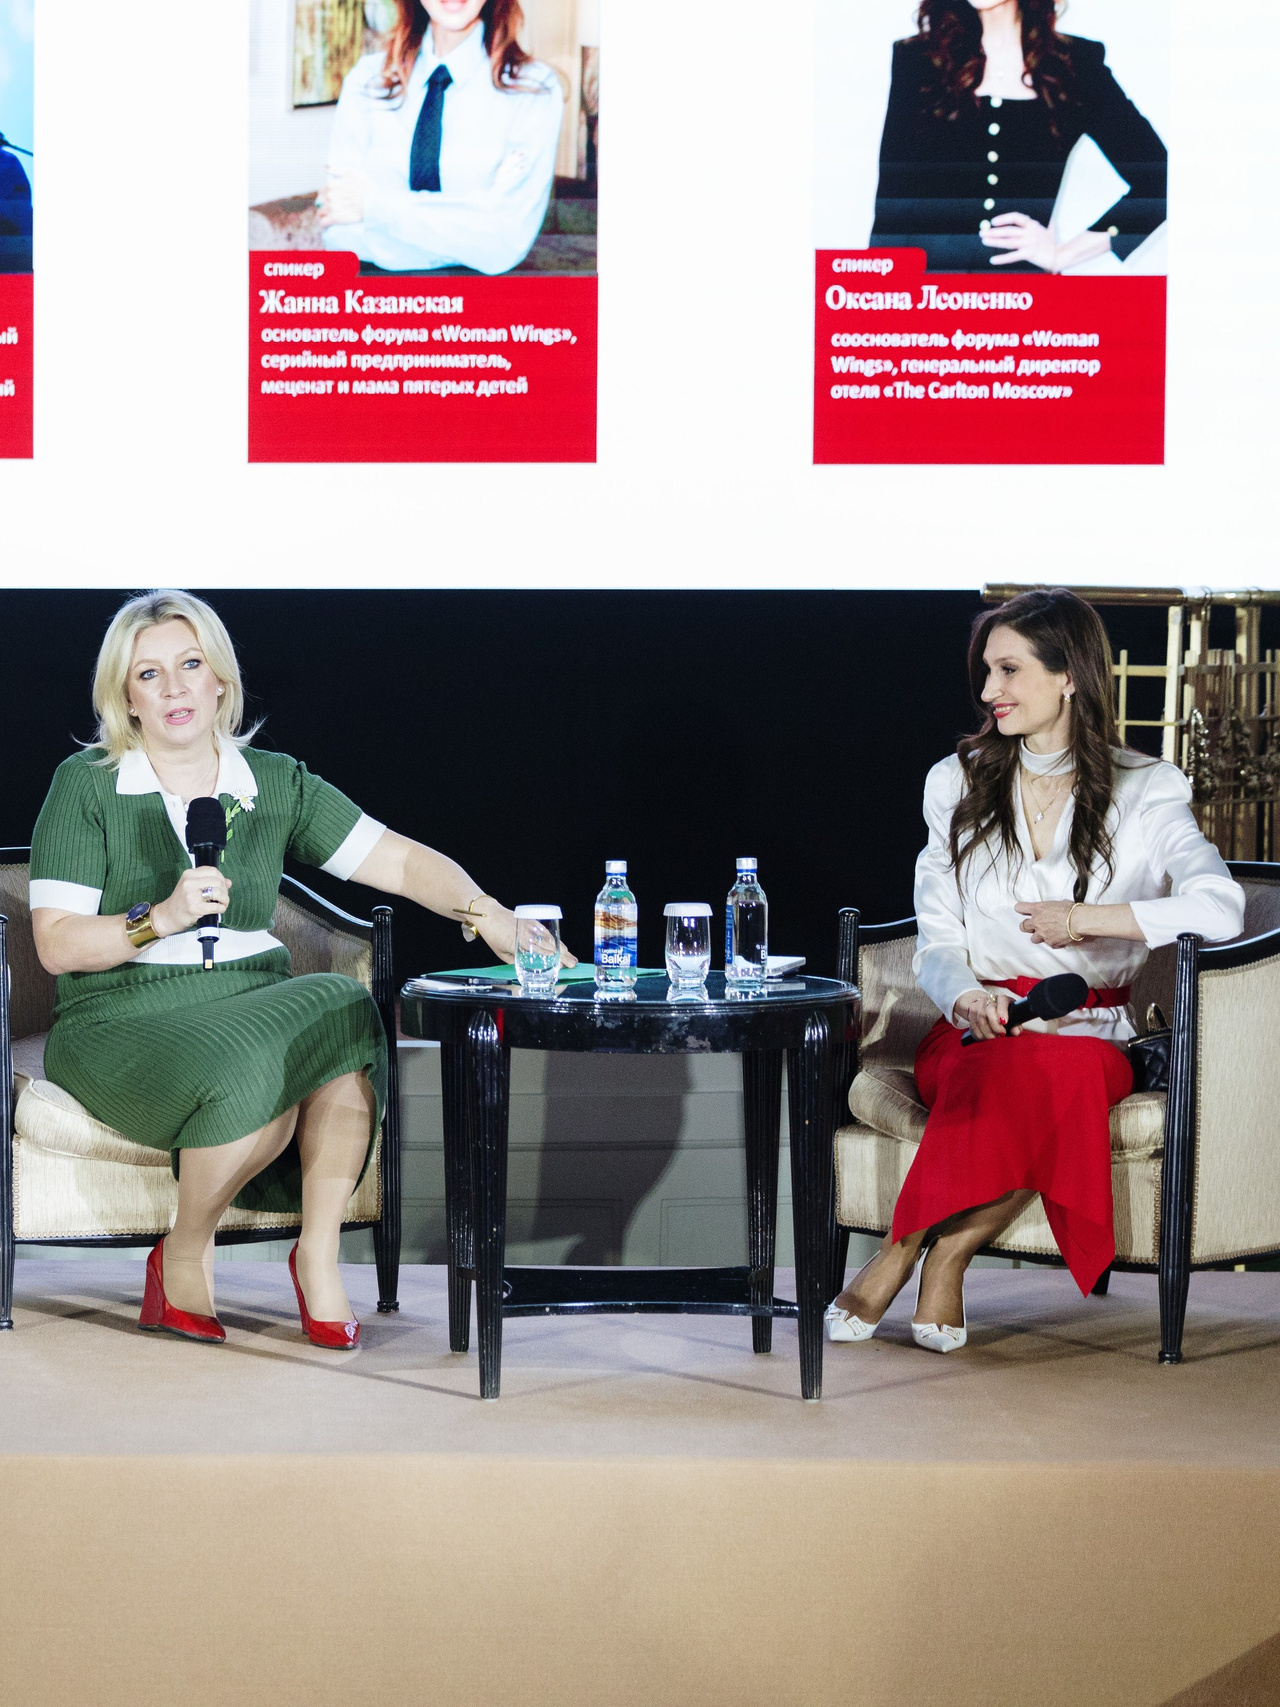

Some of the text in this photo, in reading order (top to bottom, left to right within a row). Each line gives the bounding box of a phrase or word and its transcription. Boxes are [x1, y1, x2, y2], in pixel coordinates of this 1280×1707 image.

[263, 260, 325, 279] спикер
[832, 257, 894, 275] спикер
[259, 290, 463, 314] Жанна Казанская
[826, 285, 913, 310] Оксана
[261, 328, 359, 342] основатель
[361, 324, 428, 345] форума
[432, 325, 508, 342] «Woman
[831, 333, 949, 347] сооснователь
[951, 329, 1019, 350] форума
[261, 350, 511, 371] серийный предприниматель,
[901, 356, 1015, 376] генеральный
[1017, 359, 1101, 377] директор
[261, 376, 528, 397] меценат и мама пятерых детей
[830, 385, 880, 399] отеля
[928, 381, 989, 399] Carlton
[601, 953, 631, 965] Baikal
